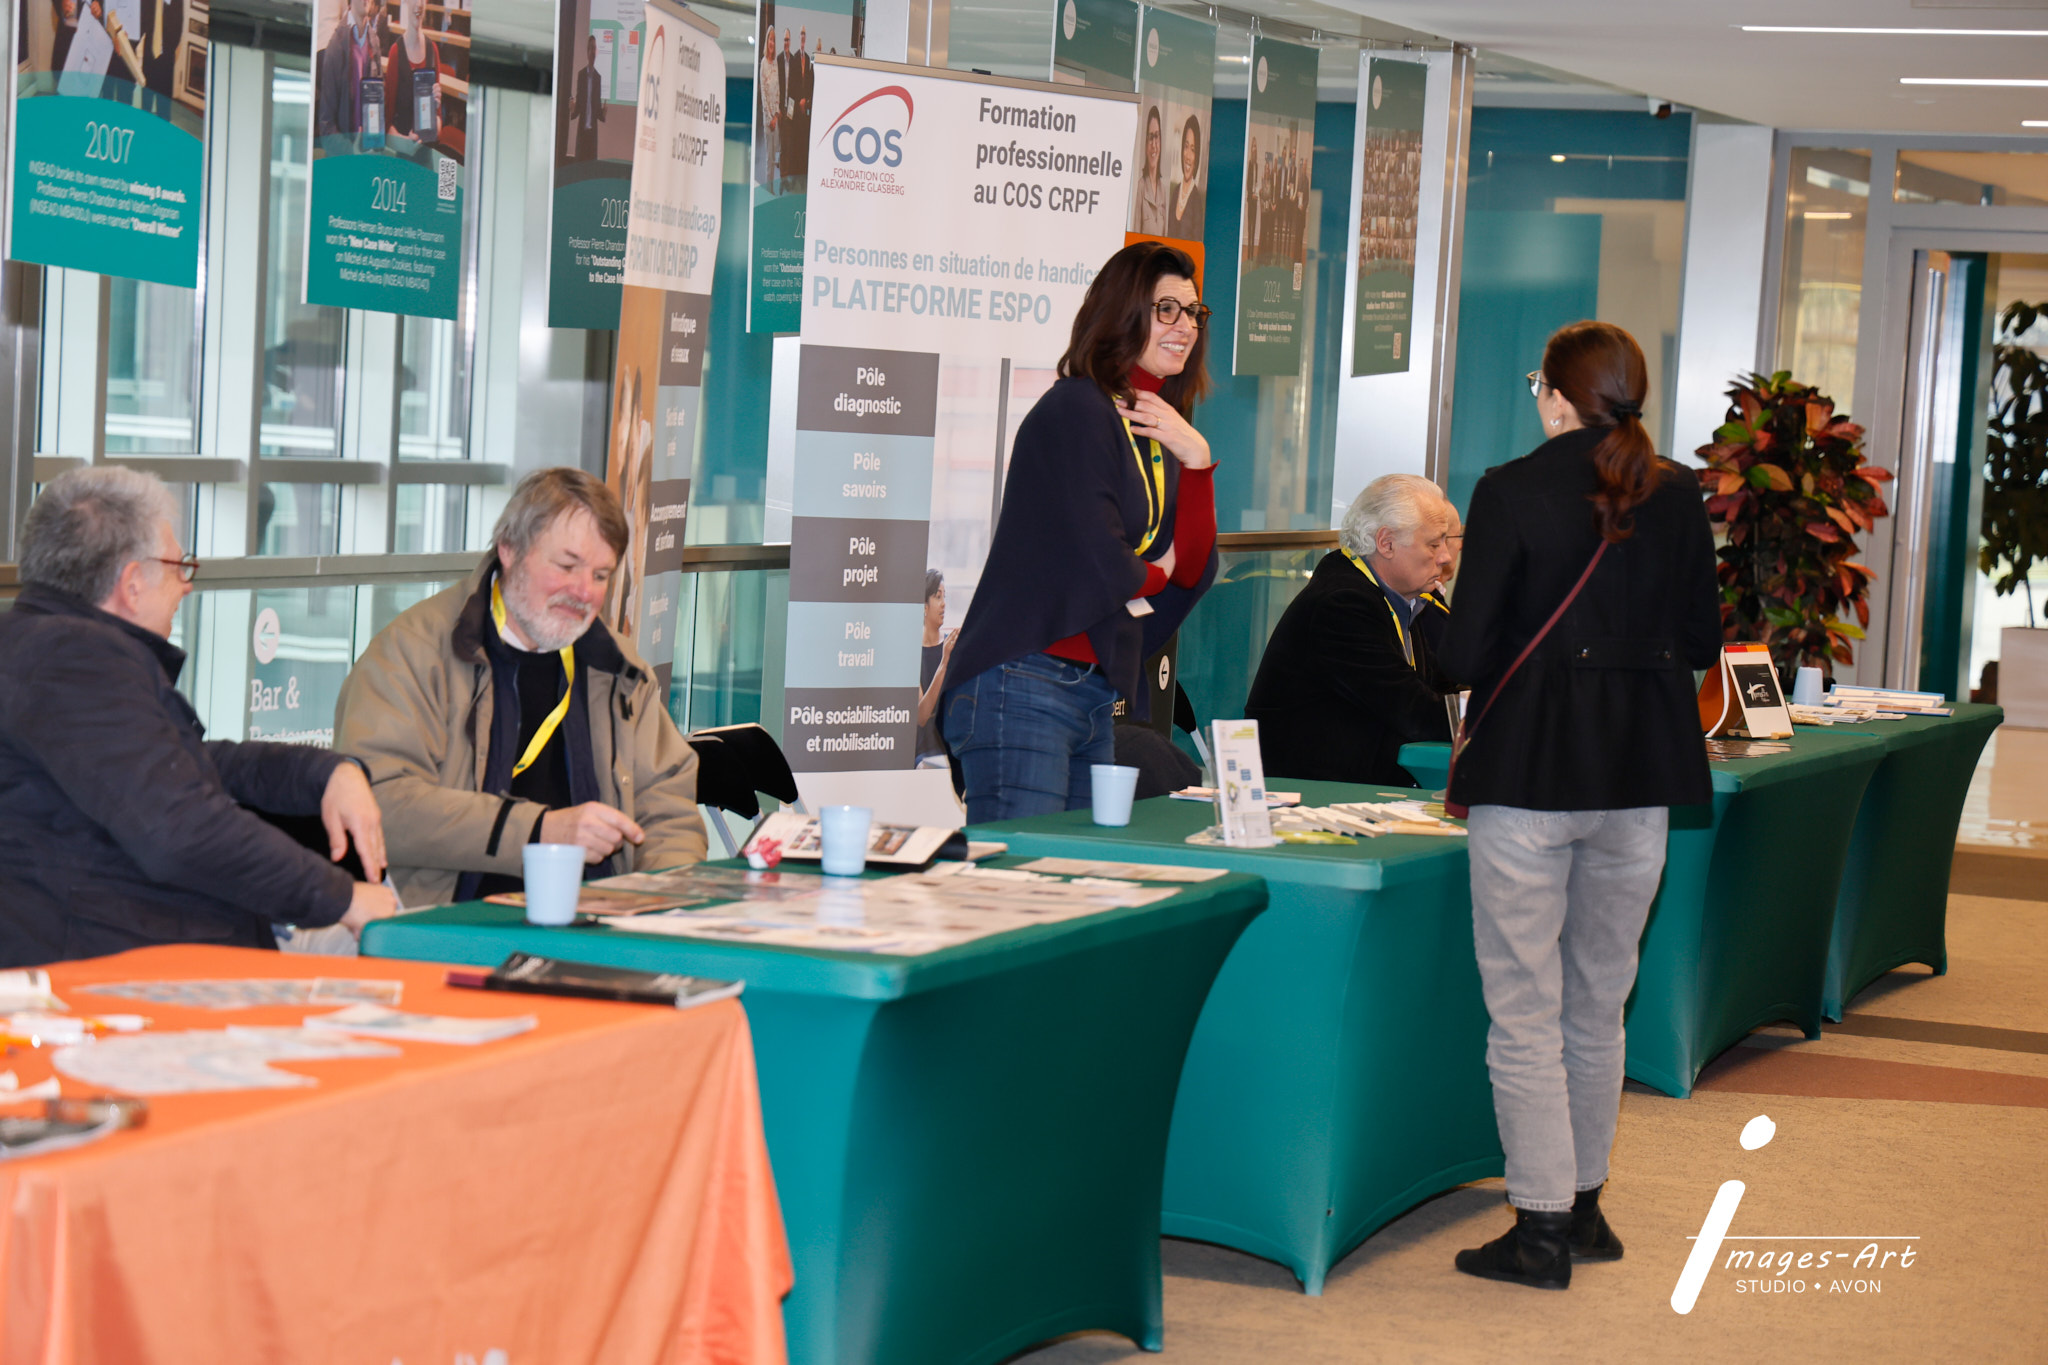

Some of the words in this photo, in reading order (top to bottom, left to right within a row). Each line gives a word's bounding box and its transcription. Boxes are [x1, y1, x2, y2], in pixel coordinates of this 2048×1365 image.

[979, 97, 1077, 133] Formation
[85, 121, 134, 164] 2007
[832, 124, 903, 168] COS
[976, 140, 1122, 178] professionnelle
[833, 167, 878, 182] FONDATION
[879, 171, 895, 184] COS
[371, 176, 407, 213] 2014
[820, 178, 866, 192] ALEXANDRE
[867, 182, 905, 196] GLASBERG
[974, 183, 998, 205] au
[1003, 182, 1043, 210] COS
[1048, 187, 1101, 214] CRPF
[600, 198, 629, 229] 2016
[794, 211, 806, 238] 20
[568, 236, 591, 249] Professor
[814, 239, 908, 269] Personnes
[912, 251, 934, 271] en
[939, 252, 1010, 279] situation
[1014, 257, 1034, 281] de
[1038, 258, 1100, 286] handic
[604, 272, 616, 284] Case
[812, 276, 983, 320] PLATEFORME
[988, 291, 1051, 324] ESPO
[856, 366, 886, 388] Pôle
[834, 393, 902, 417] diagnostic
[853, 451, 881, 472] Pôle
[842, 480, 887, 500] savoirs
[849, 536, 876, 556] Pôle
[843, 565, 878, 587] projet
[845, 621, 871, 641] Pôle
[838, 648, 875, 668] travail
[249, 678, 283, 712] Bar
[285, 676, 300, 710] &
[790, 704, 824, 726] Pôle
[825, 704, 910, 726] sociabilisation
[806, 733, 821, 753] et
[823, 732, 895, 753] mobilisation
